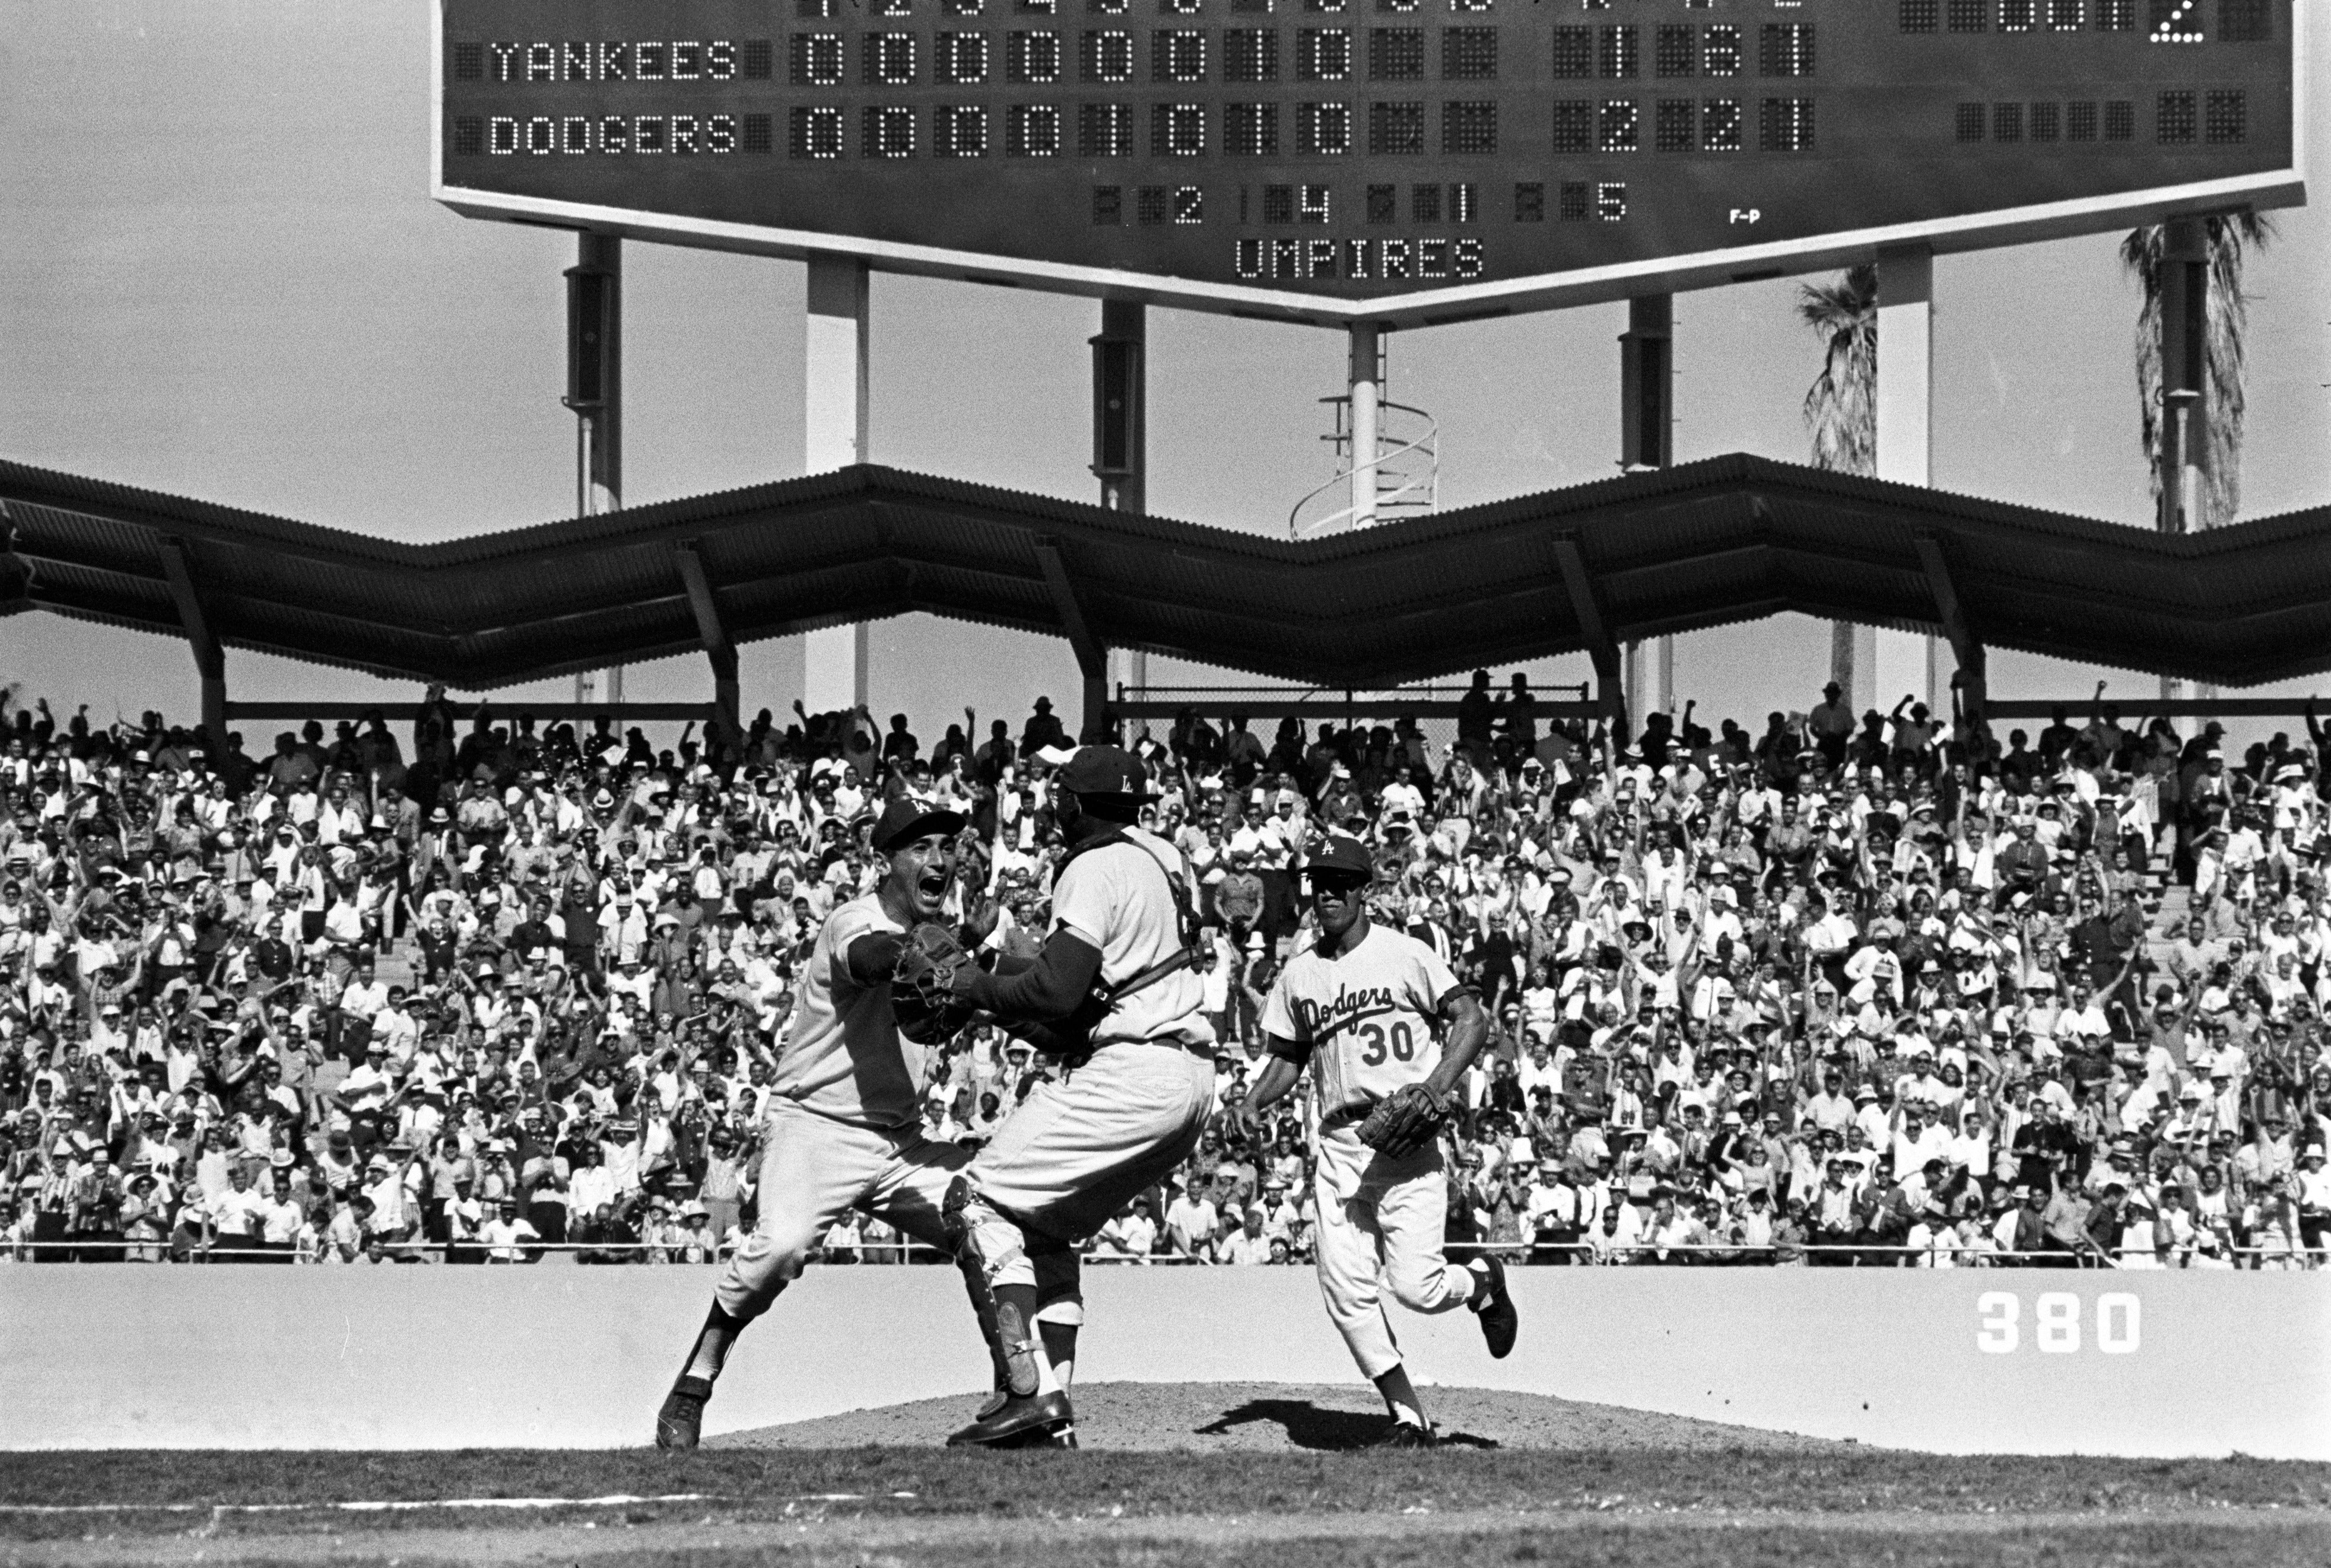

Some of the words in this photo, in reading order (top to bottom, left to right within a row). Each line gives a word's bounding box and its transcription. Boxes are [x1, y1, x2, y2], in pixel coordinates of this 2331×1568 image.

[491, 41, 735, 81] YANKEES
[808, 34, 843, 84] 0
[879, 33, 915, 84] 0
[952, 33, 987, 83] 0
[1025, 31, 1059, 82] 0
[1097, 31, 1132, 81] 0
[1170, 31, 1205, 81] 0
[1315, 29, 1350, 79] 0
[491, 115, 735, 154] DODGERS
[806, 108, 843, 158] 0
[879, 108, 914, 157] 0
[952, 106, 987, 156] 0
[1024, 106, 1059, 156] 0
[1169, 104, 1204, 155] 0
[1315, 103, 1349, 154] 0
[1601, 101, 1637, 152] 2
[1704, 100, 1740, 150] 2
[1176, 186, 1201, 224] 2
[1302, 186, 1329, 223] 4
[1599, 182, 1625, 221] 5
[1730, 209, 1760, 224] F-P
[1236, 239, 1482, 278] UMPIRES
[911, 800, 932, 814] LA
[1322, 839, 1335, 855] LA
[1299, 982, 1396, 1037] Dodgers
[1359, 1021, 1414, 1067] 30
[1977, 1291, 2141, 1353] 380
